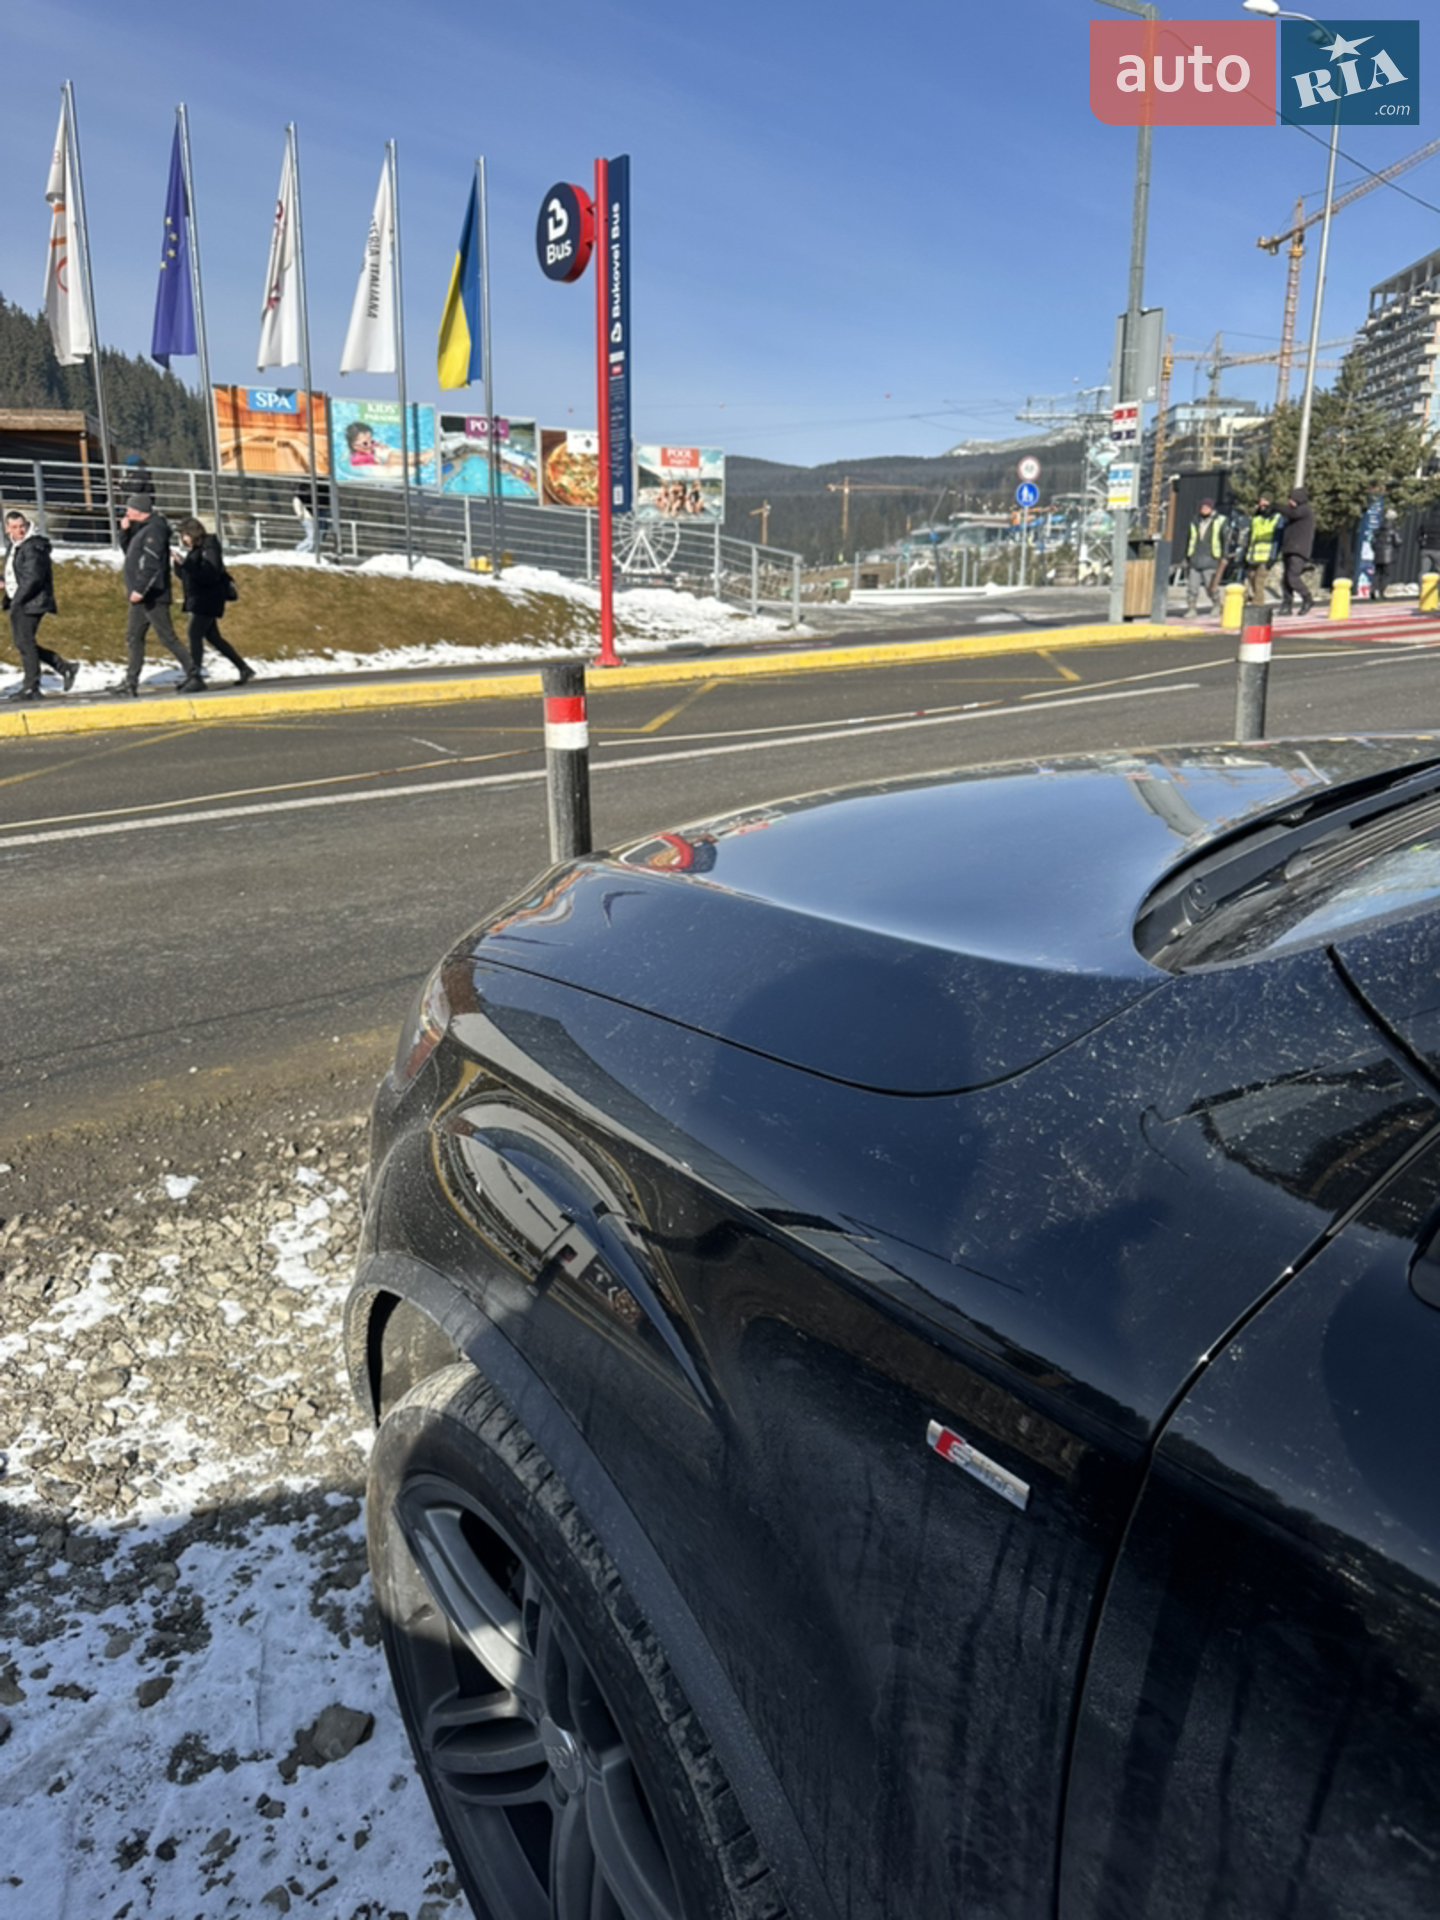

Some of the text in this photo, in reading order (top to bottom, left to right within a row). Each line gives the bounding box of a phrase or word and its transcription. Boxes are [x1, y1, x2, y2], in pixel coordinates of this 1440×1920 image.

[611, 202, 620, 239] Bus
[366, 262, 380, 319] ITALIANA
[611, 243, 621, 318] Bukovel
[255, 391, 292, 410] SPA
